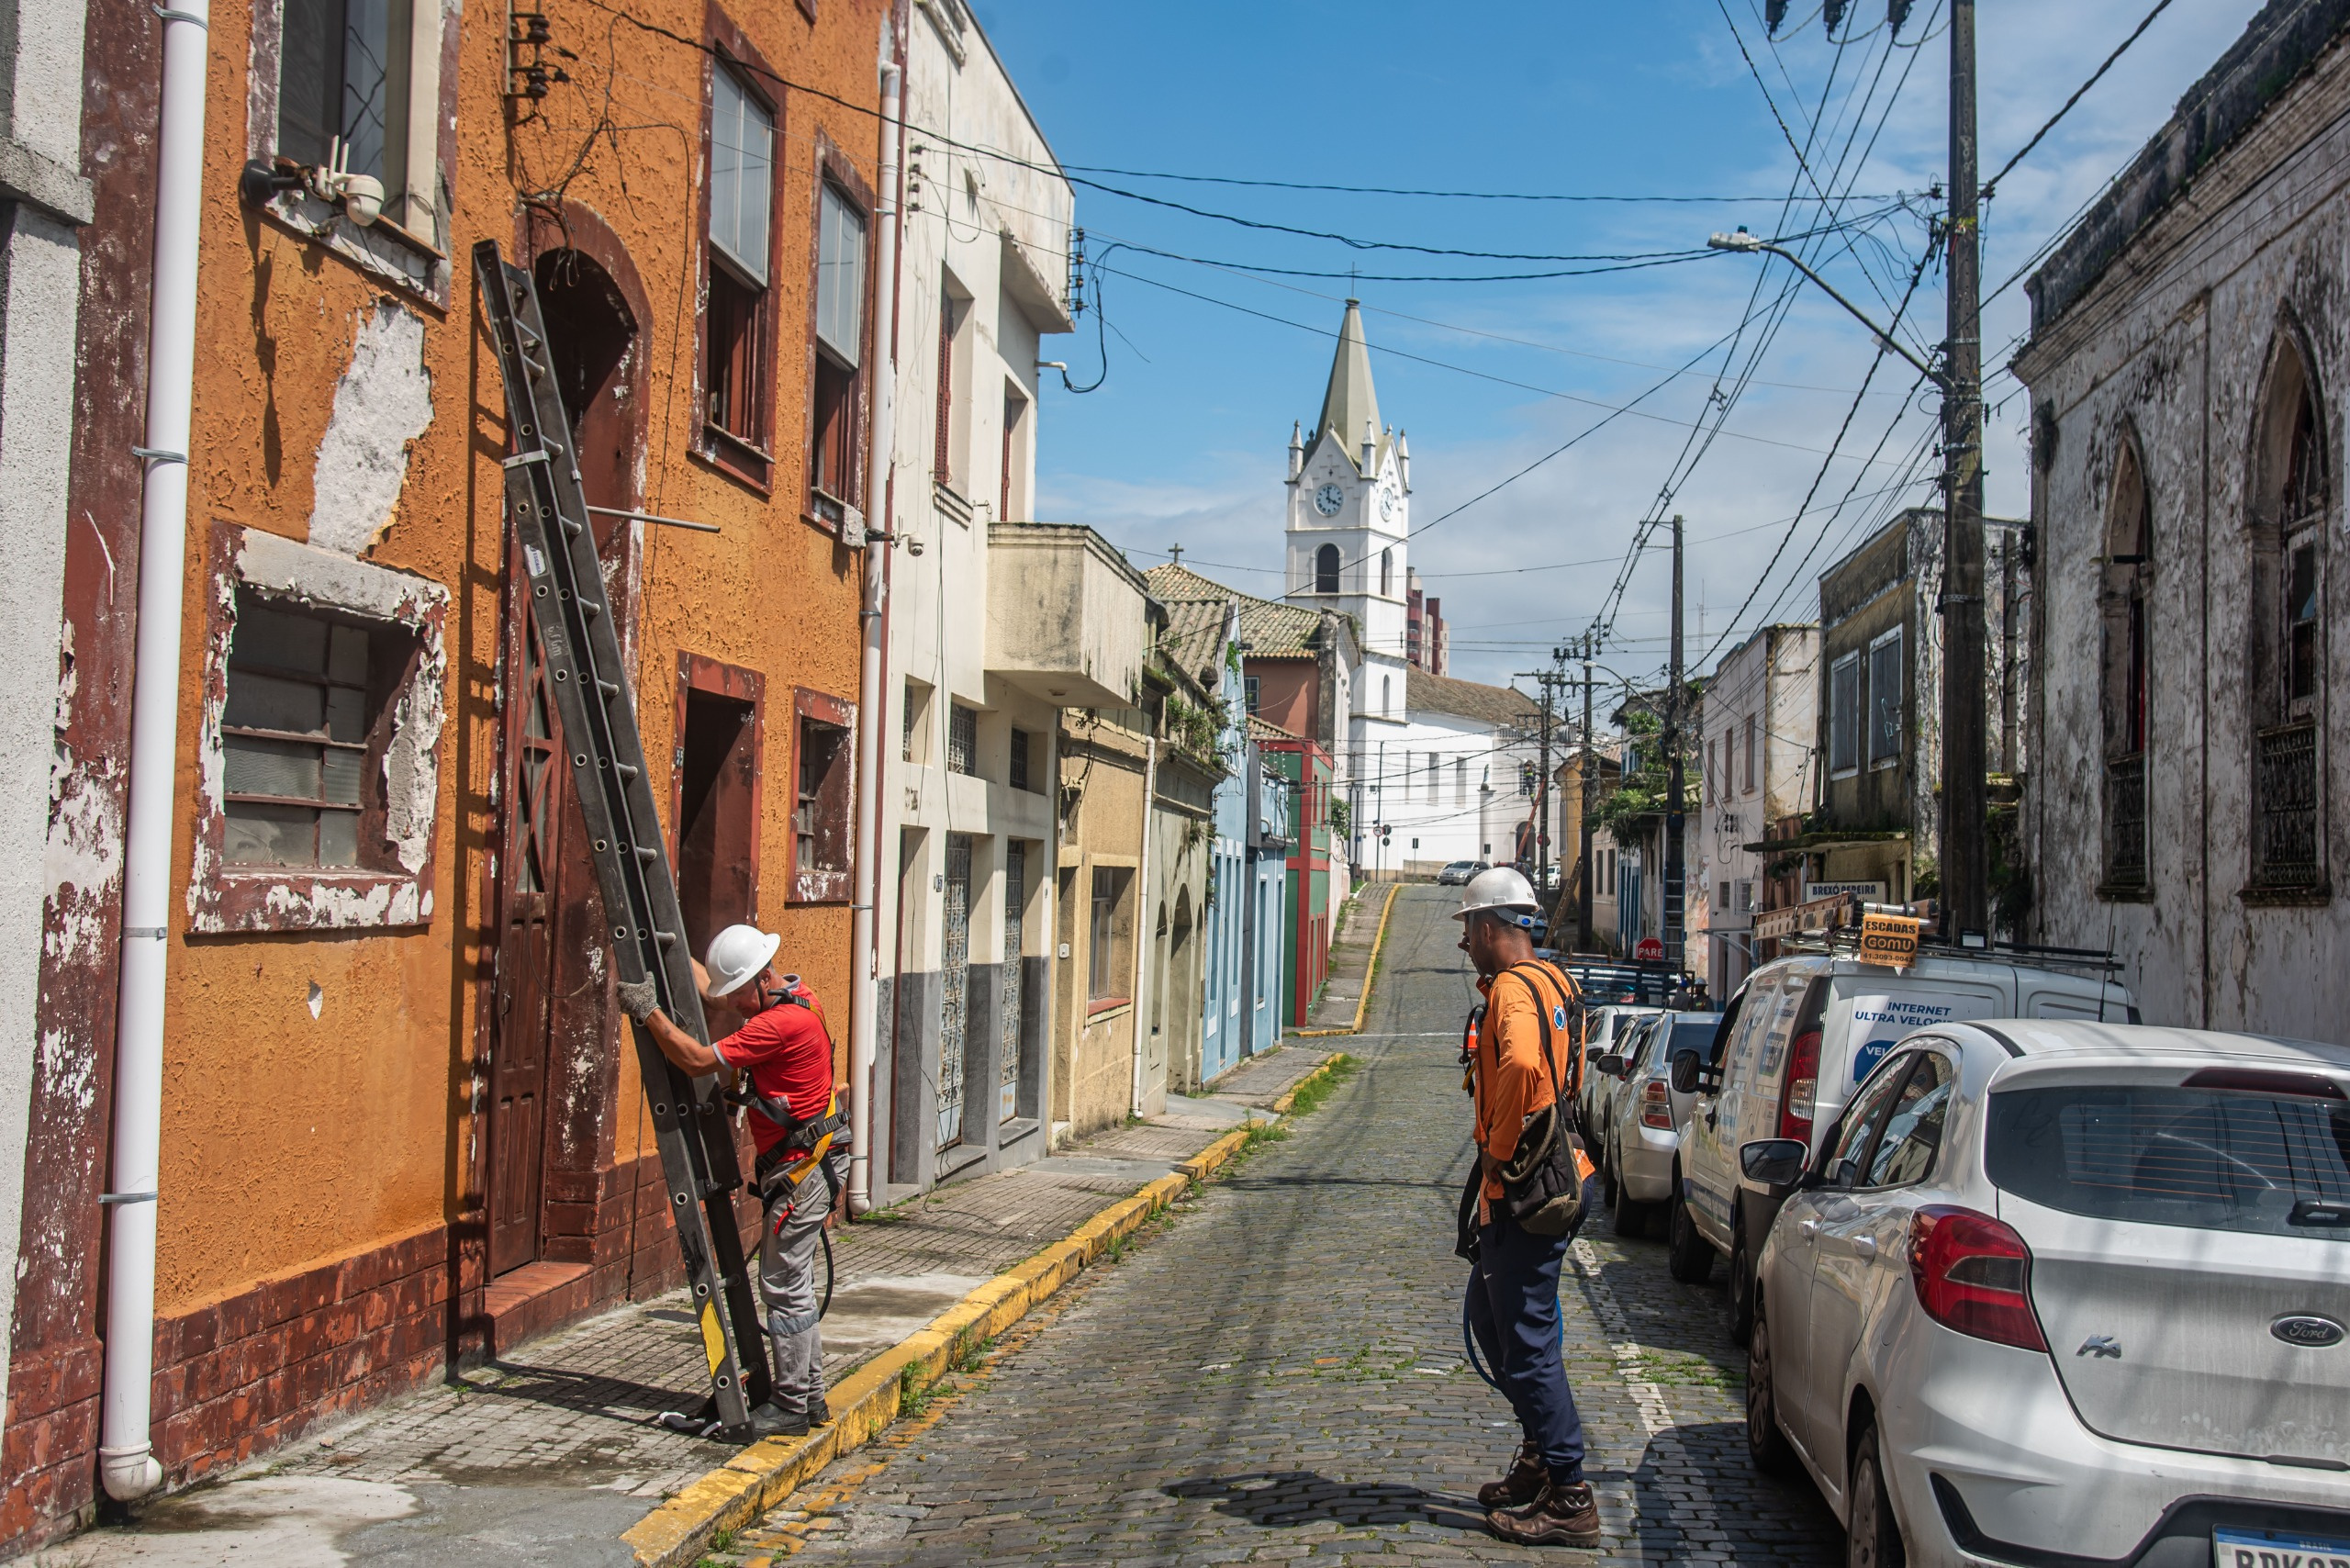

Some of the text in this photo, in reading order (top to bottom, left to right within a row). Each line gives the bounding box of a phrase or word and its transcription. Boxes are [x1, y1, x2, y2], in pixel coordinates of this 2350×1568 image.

[1812, 883, 1840, 895] BREXÓ
[1865, 921, 1916, 934] ESCADAS
[1868, 937, 1911, 951] GOMU
[1639, 947, 1663, 958] PARE
[1863, 952, 1914, 962] 41.3093-0043
[1887, 1002, 1952, 1016] INTERNET
[1855, 1011, 1896, 1024] ULTRA
[2288, 1320, 2329, 1340] Ford
[2299, 1540, 2333, 1551] BRASIL
